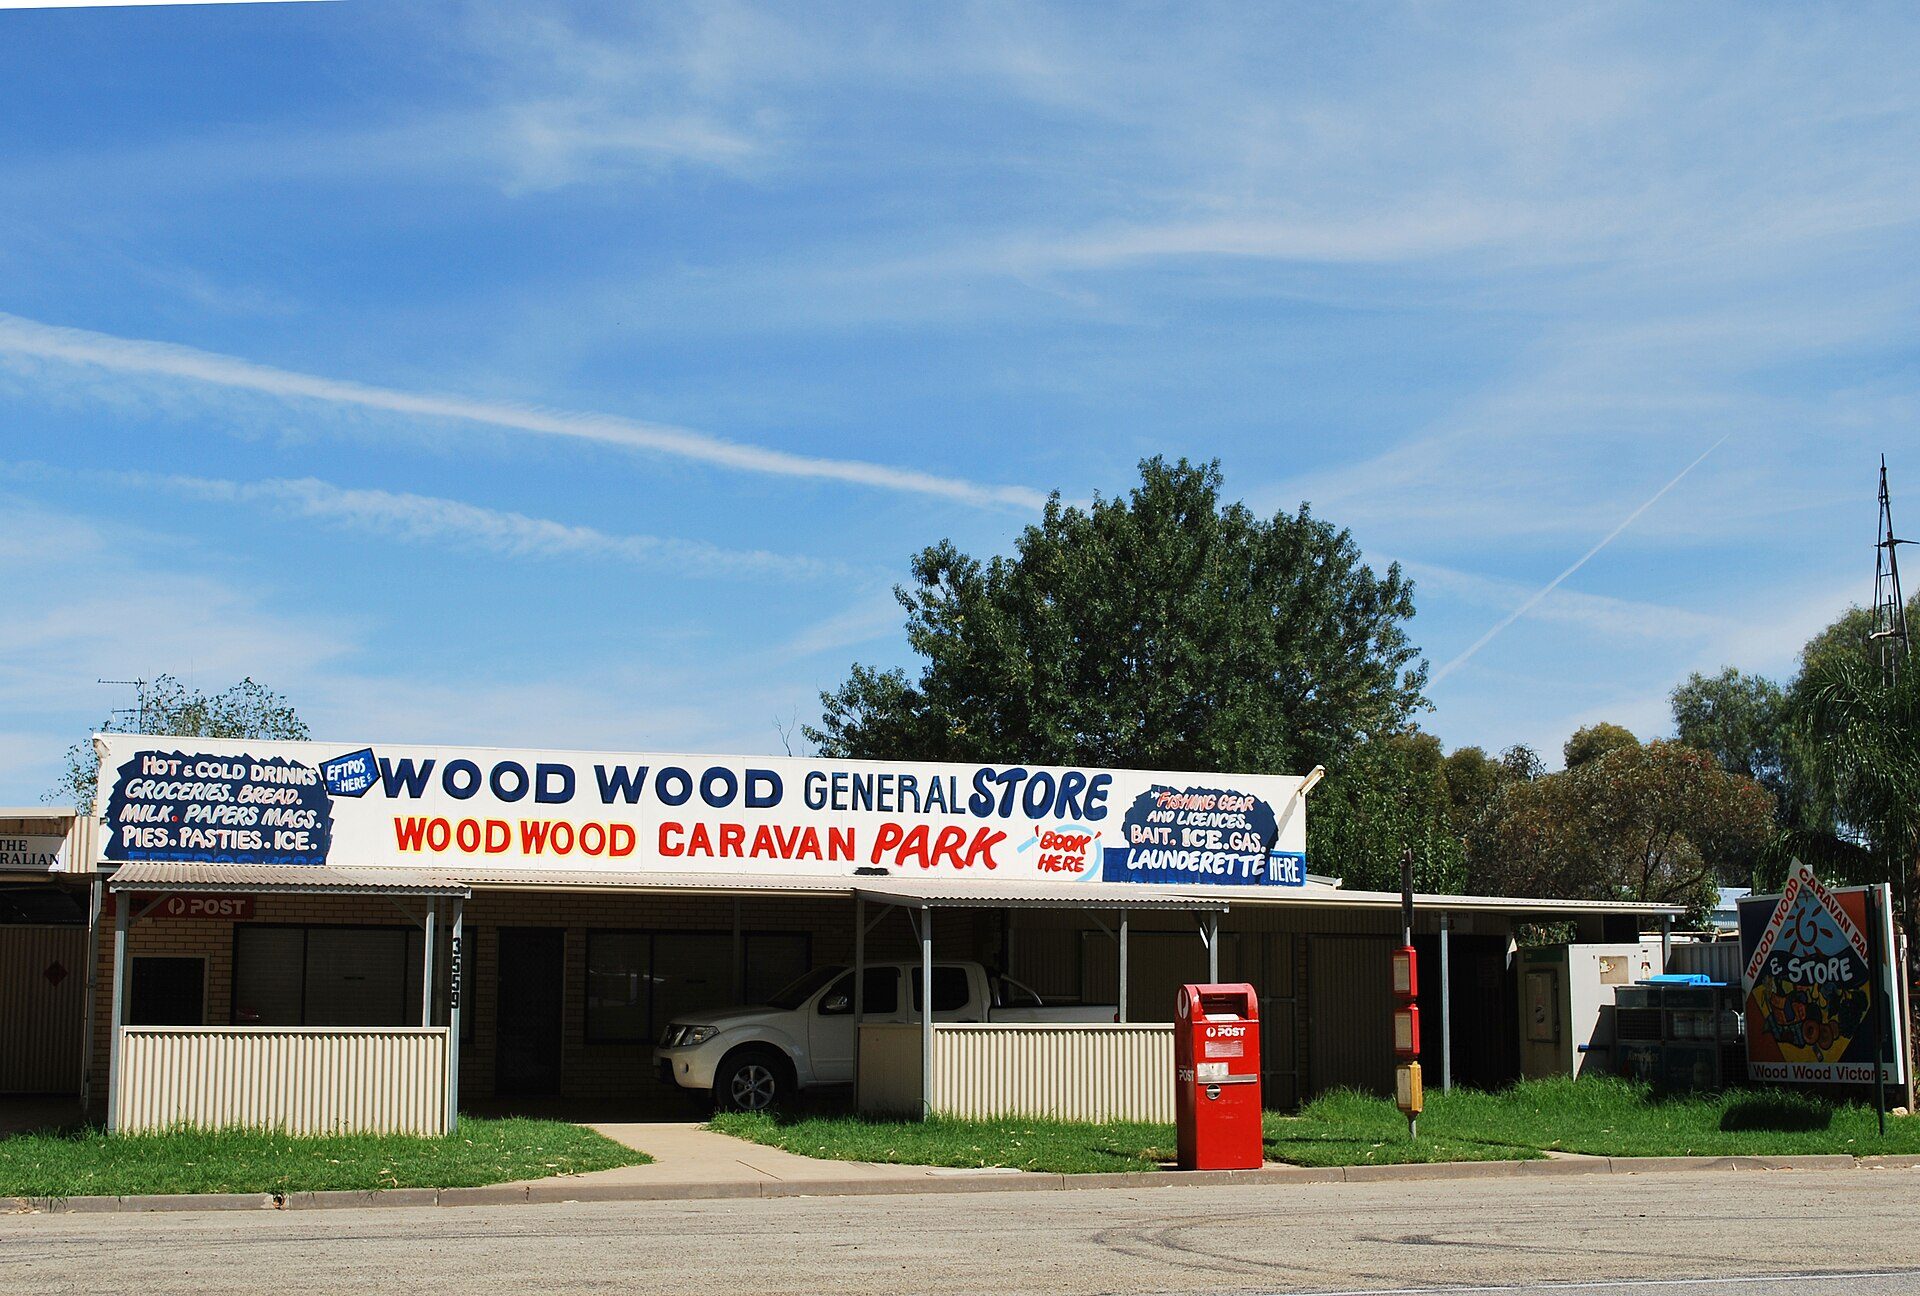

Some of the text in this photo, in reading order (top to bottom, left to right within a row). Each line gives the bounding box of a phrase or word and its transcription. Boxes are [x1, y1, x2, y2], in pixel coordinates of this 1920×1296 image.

[142, 756, 317, 786] HOT & COLD DRINKS
[326, 757, 366, 781] EFTPOS
[341, 776, 367, 792] HERE
[378, 758, 1113, 821] WOOD WOOD GENERAL STORE
[1156, 791, 1255, 813] FISHING GEAR
[182, 805, 260, 826] PAPERS
[1146, 810, 1174, 825] AND
[0, 839, 28, 852] THE
[394, 817, 1008, 870] WOOD WOOD CARAVAN PARK
[1037, 853, 1085, 873] HERE
[1126, 848, 1301, 884] LAUNDERETTE HERE
[190, 899, 247, 916] POST
[1798, 868, 1869, 963] CARAVAN PA
[1747, 878, 1799, 980] WOOD WOOD
[1769, 957, 1854, 985] & STORE
[1217, 1027, 1246, 1037] POST
[1178, 1069, 1195, 1082] POST
[1753, 1064, 1889, 1082] Wood Wood Victora
